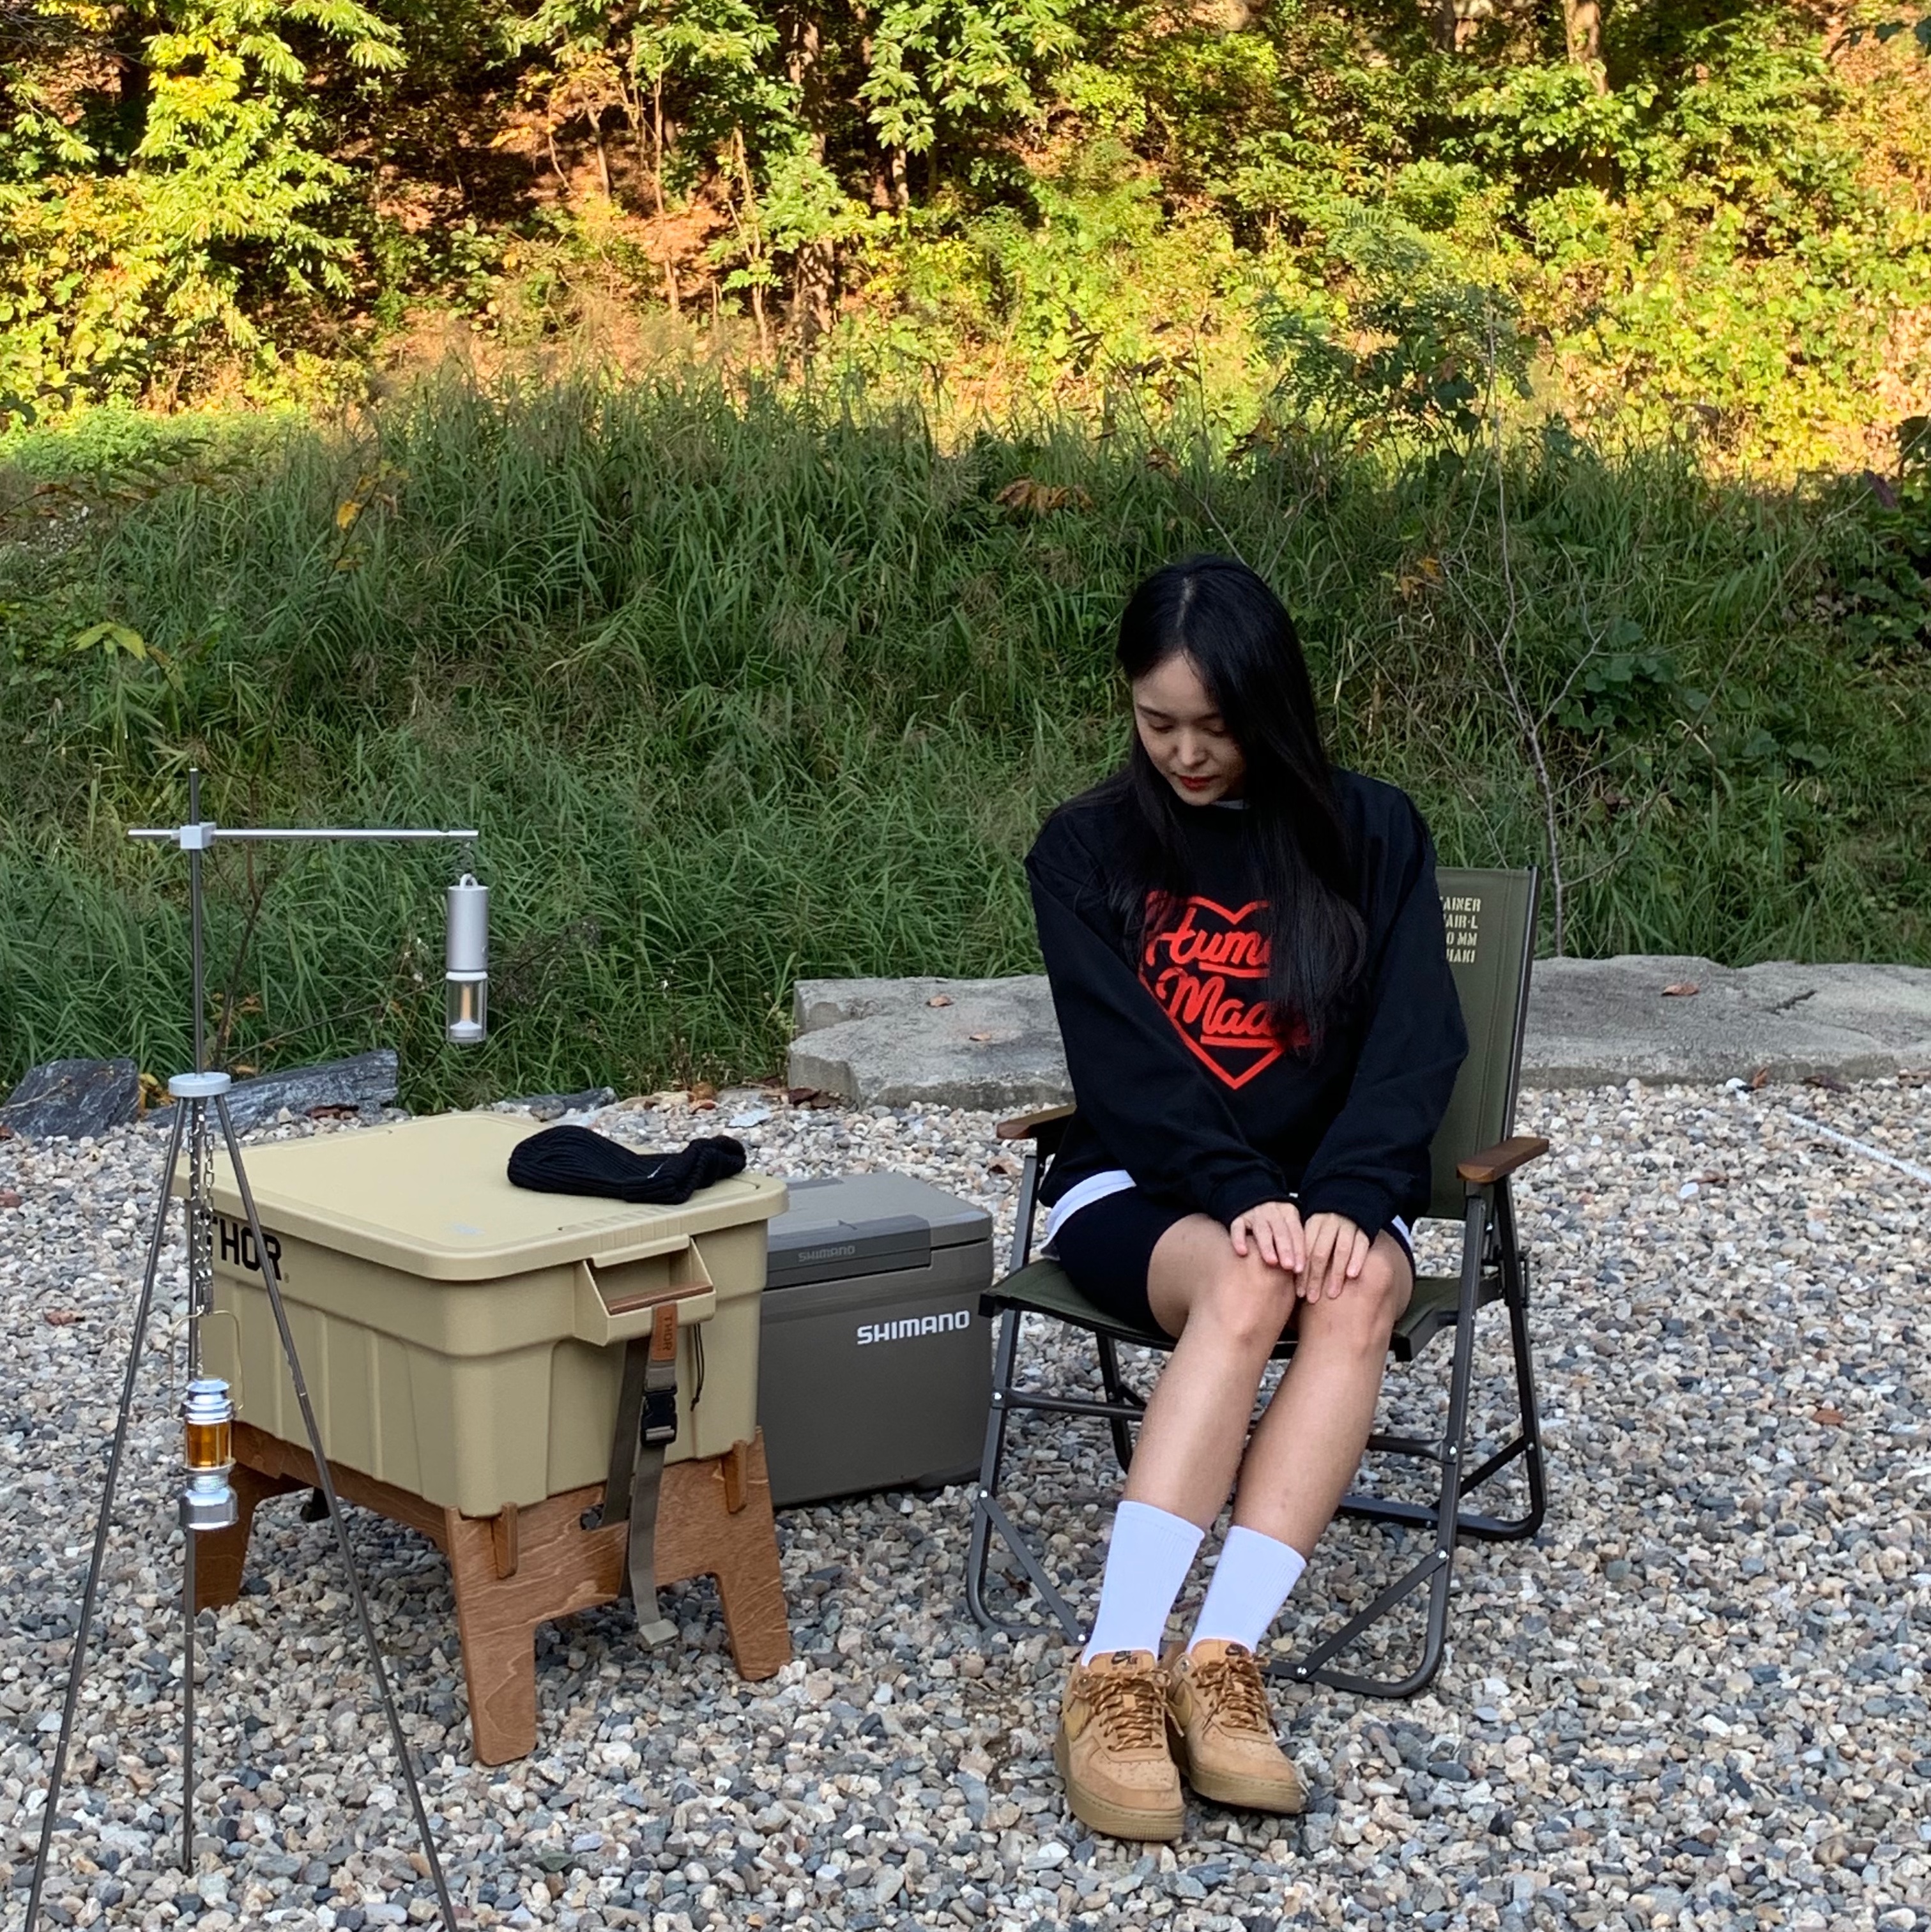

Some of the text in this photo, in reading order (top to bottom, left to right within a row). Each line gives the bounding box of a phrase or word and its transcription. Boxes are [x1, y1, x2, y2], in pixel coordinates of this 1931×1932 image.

[1439, 896, 1481, 912] AINER
[1444, 914, 1479, 929] AIR-L
[1457, 932, 1477, 946] MM
[798, 1245, 855, 1262] SHIMANO
[662, 1316, 673, 1350] THOR
[857, 1310, 970, 1345] SHIMANO
